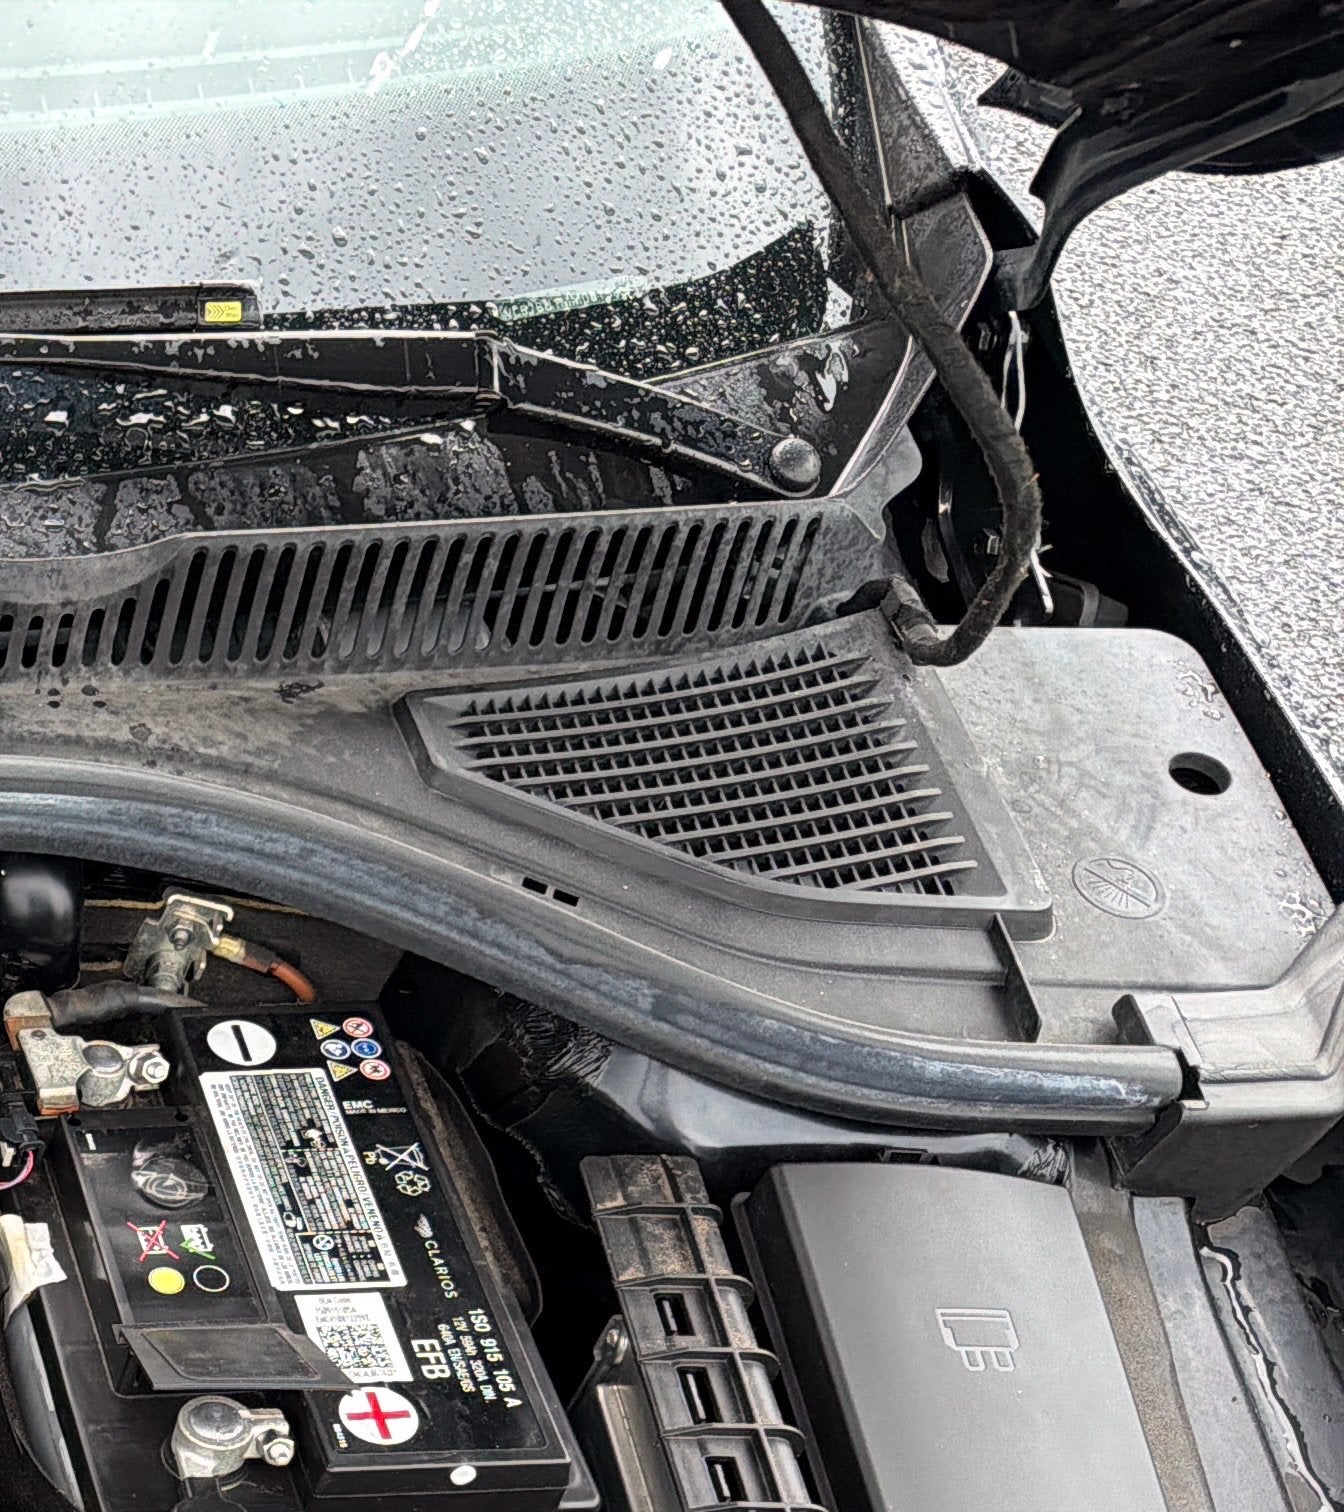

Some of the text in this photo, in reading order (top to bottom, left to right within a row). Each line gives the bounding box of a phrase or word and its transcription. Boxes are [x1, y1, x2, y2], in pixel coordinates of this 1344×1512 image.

[342, 1100, 373, 1109] EMC
[363, 1151, 378, 1165] Pb
[424, 1240, 458, 1299] CLARIOS
[438, 1323, 456, 1346] 640A
[411, 1339, 452, 1381] EFB
[452, 1317, 470, 1332] 12V
[470, 1359, 489, 1382] 320A
[480, 1338, 505, 1362] 915
[493, 1369, 517, 1392] 105
[503, 1397, 523, 1408] A
